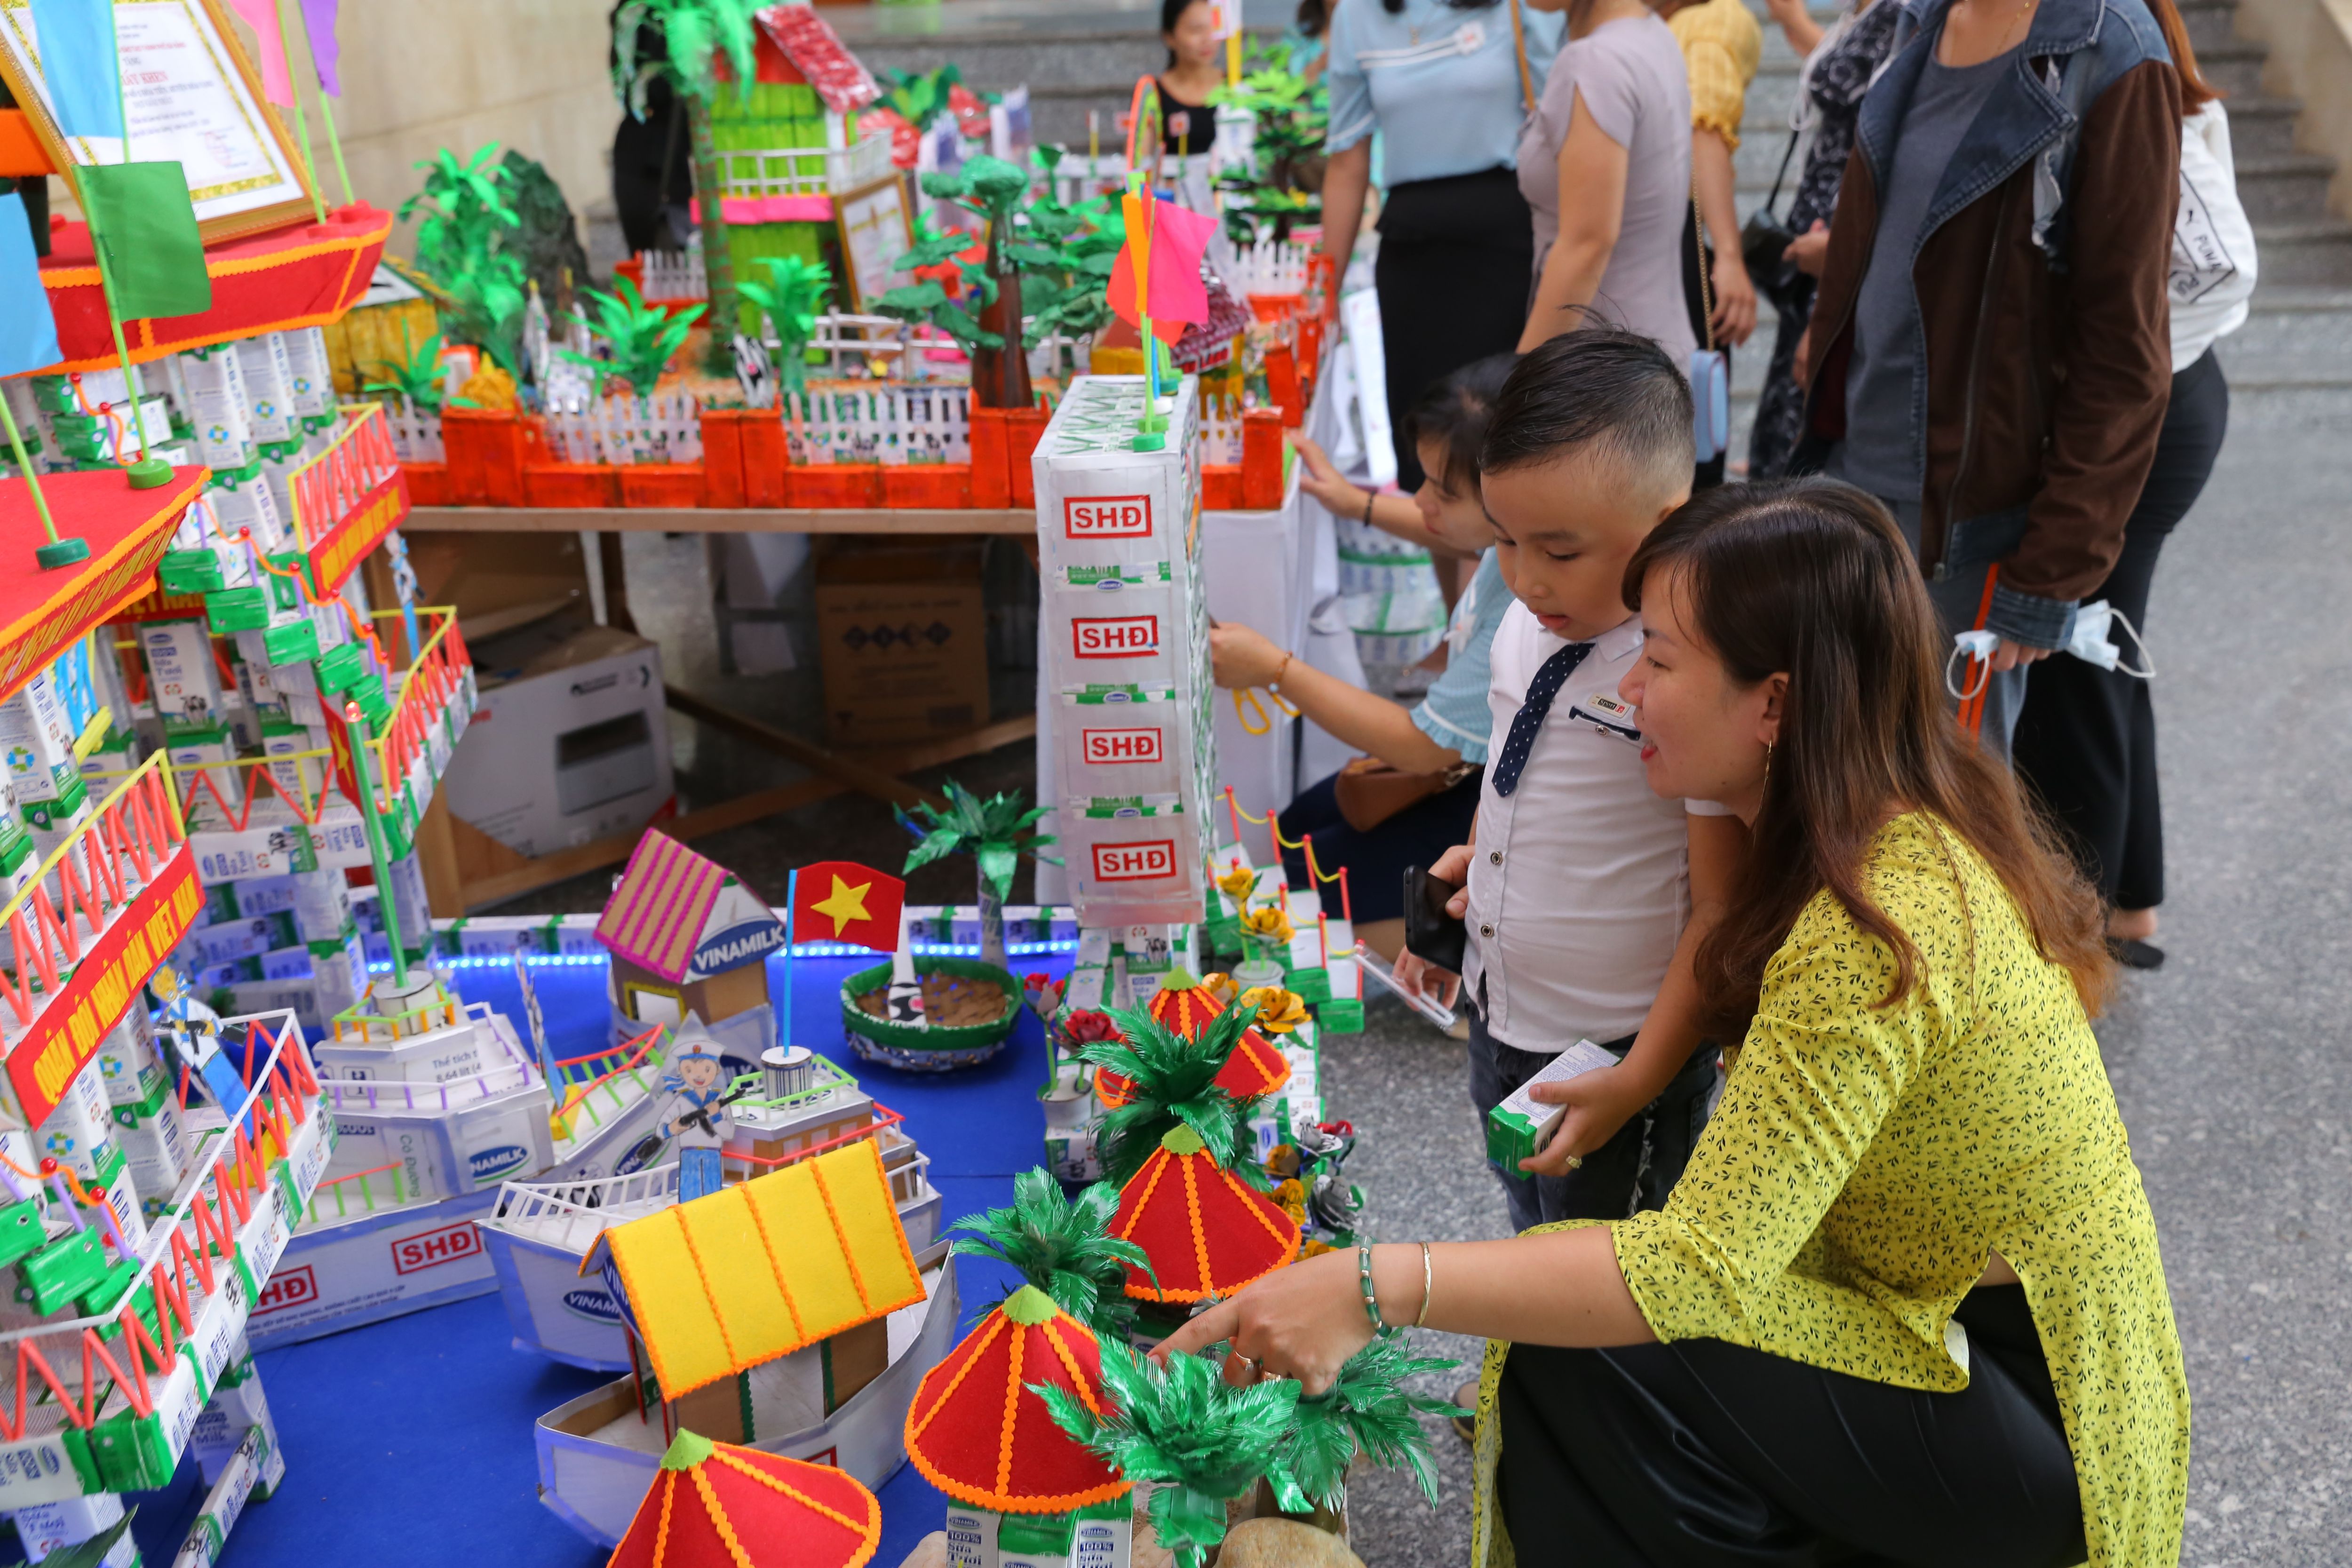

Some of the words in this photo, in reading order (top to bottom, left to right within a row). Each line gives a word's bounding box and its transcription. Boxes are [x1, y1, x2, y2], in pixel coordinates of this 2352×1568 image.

[1074, 507, 1142, 529] SHĐ
[1082, 627, 1149, 649] SHĐ
[1091, 736, 1154, 757] SHĐ
[1102, 851, 1167, 873] SHĐ
[694, 924, 785, 971] VINAMILK
[402, 1230, 471, 1266] SHĐ
[259, 1276, 308, 1306] HĐ
[950, 1518, 979, 1527] VINAMILK
[948, 1542, 971, 1553] Sữa
[950, 1531, 980, 1543] 100%
[1083, 1542, 1111, 1552] 100%
[948, 1552, 982, 1565] Tươi
